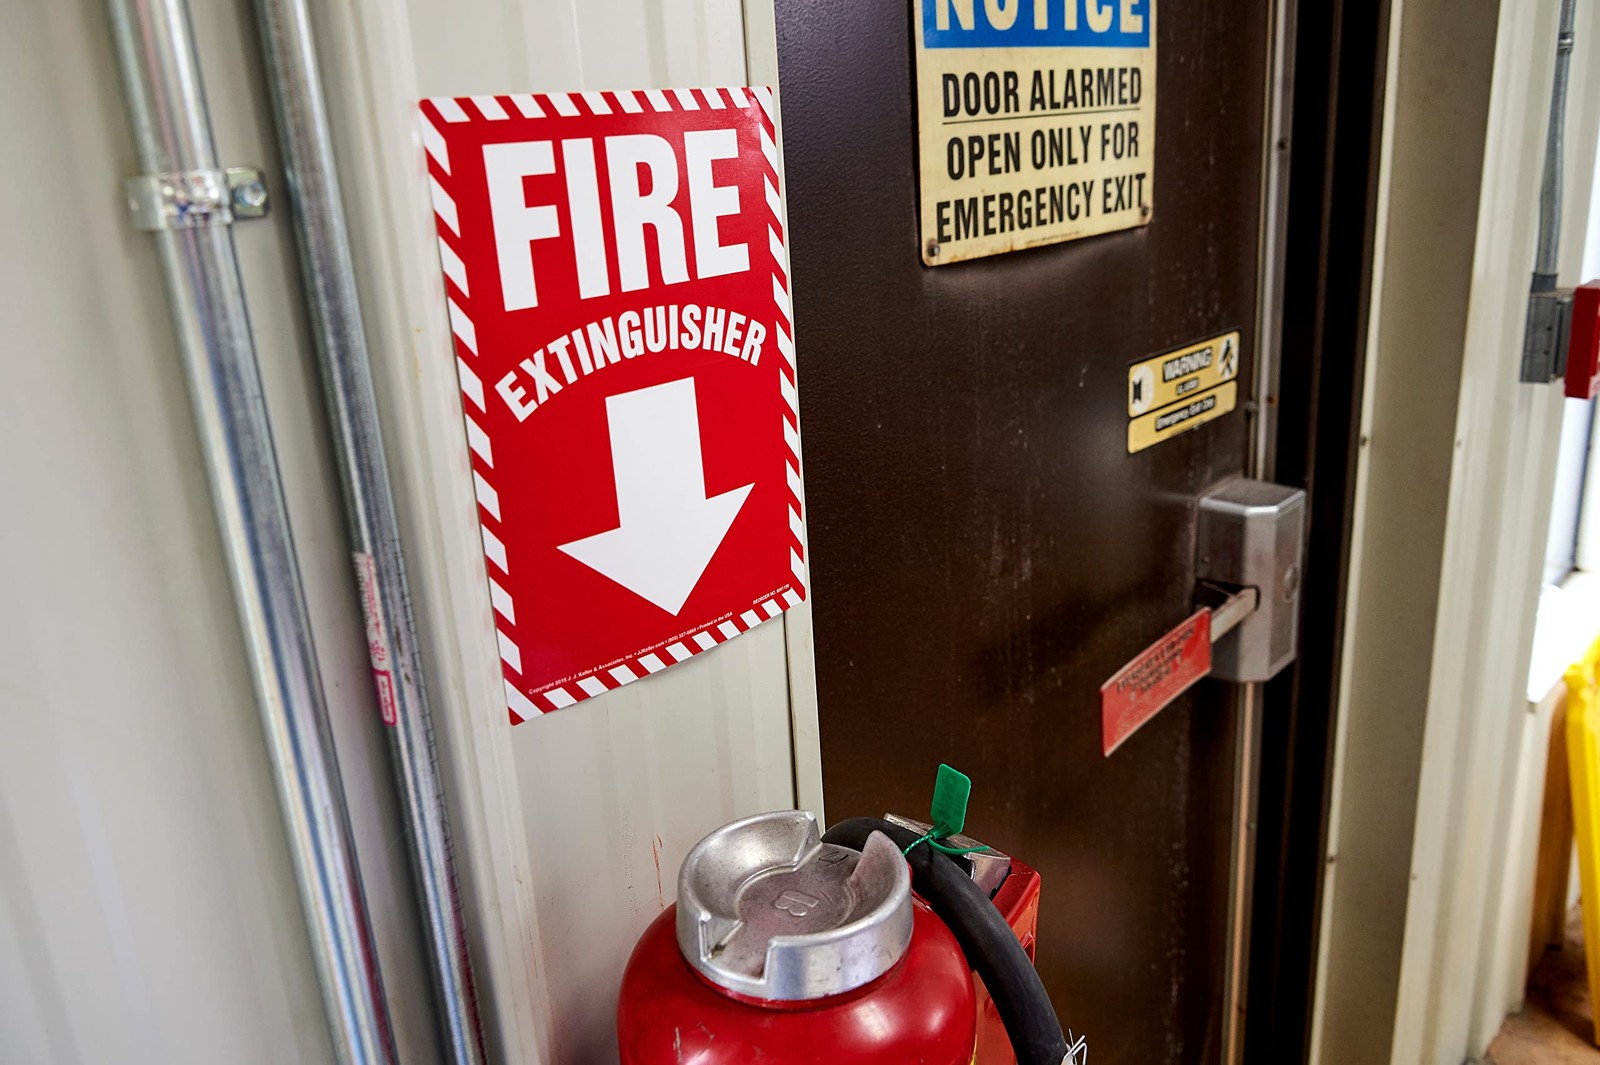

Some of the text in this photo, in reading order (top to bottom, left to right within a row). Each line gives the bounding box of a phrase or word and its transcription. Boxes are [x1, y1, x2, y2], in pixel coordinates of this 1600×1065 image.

[935, 0, 1144, 34] NOTICE
[941, 66, 1142, 118] DOOR ALARMED
[946, 121, 1139, 181] OPEN ONLY FOR
[481, 127, 751, 313] FIRE
[935, 172, 1146, 244] EMERGENCY EXIT
[493, 303, 768, 424] EXTINGUISHER
[1164, 346, 1212, 382] WARNING
[528, 681, 555, 695] Copyright
[554, 676, 568, 687] 2015
[578, 666, 593, 678] Keller
[699, 618, 714, 630] Printed
[717, 614, 725, 622] the
[724, 610, 733, 619] USA
